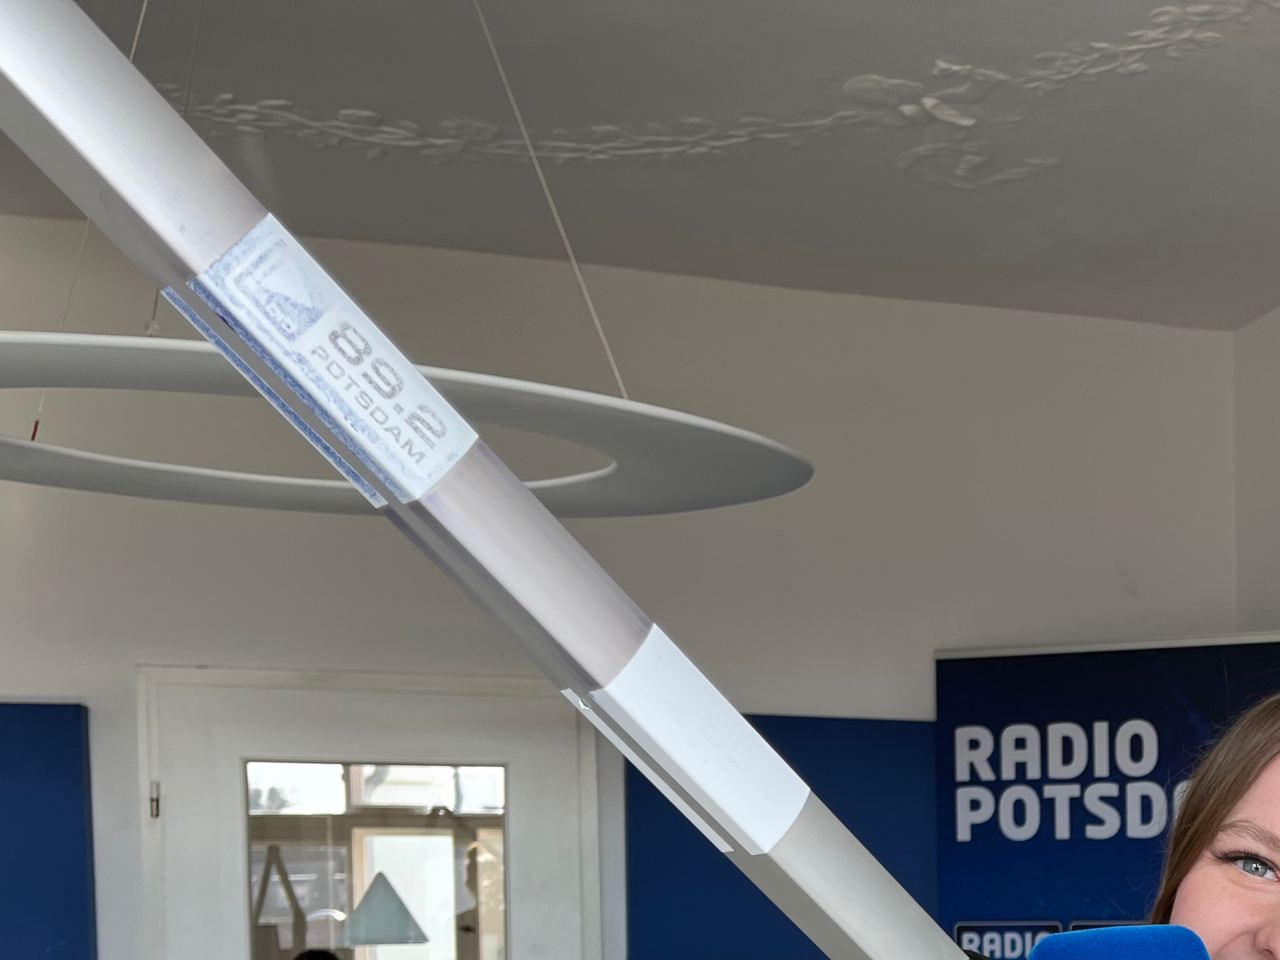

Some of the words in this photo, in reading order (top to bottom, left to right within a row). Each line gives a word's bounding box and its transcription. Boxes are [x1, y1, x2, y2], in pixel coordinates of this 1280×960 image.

[310, 344, 426, 465] POTSDAM
[328, 321, 447, 450] 89.2
[954, 719, 1159, 782] RADIO
[955, 781, 1192, 842] POTSD
